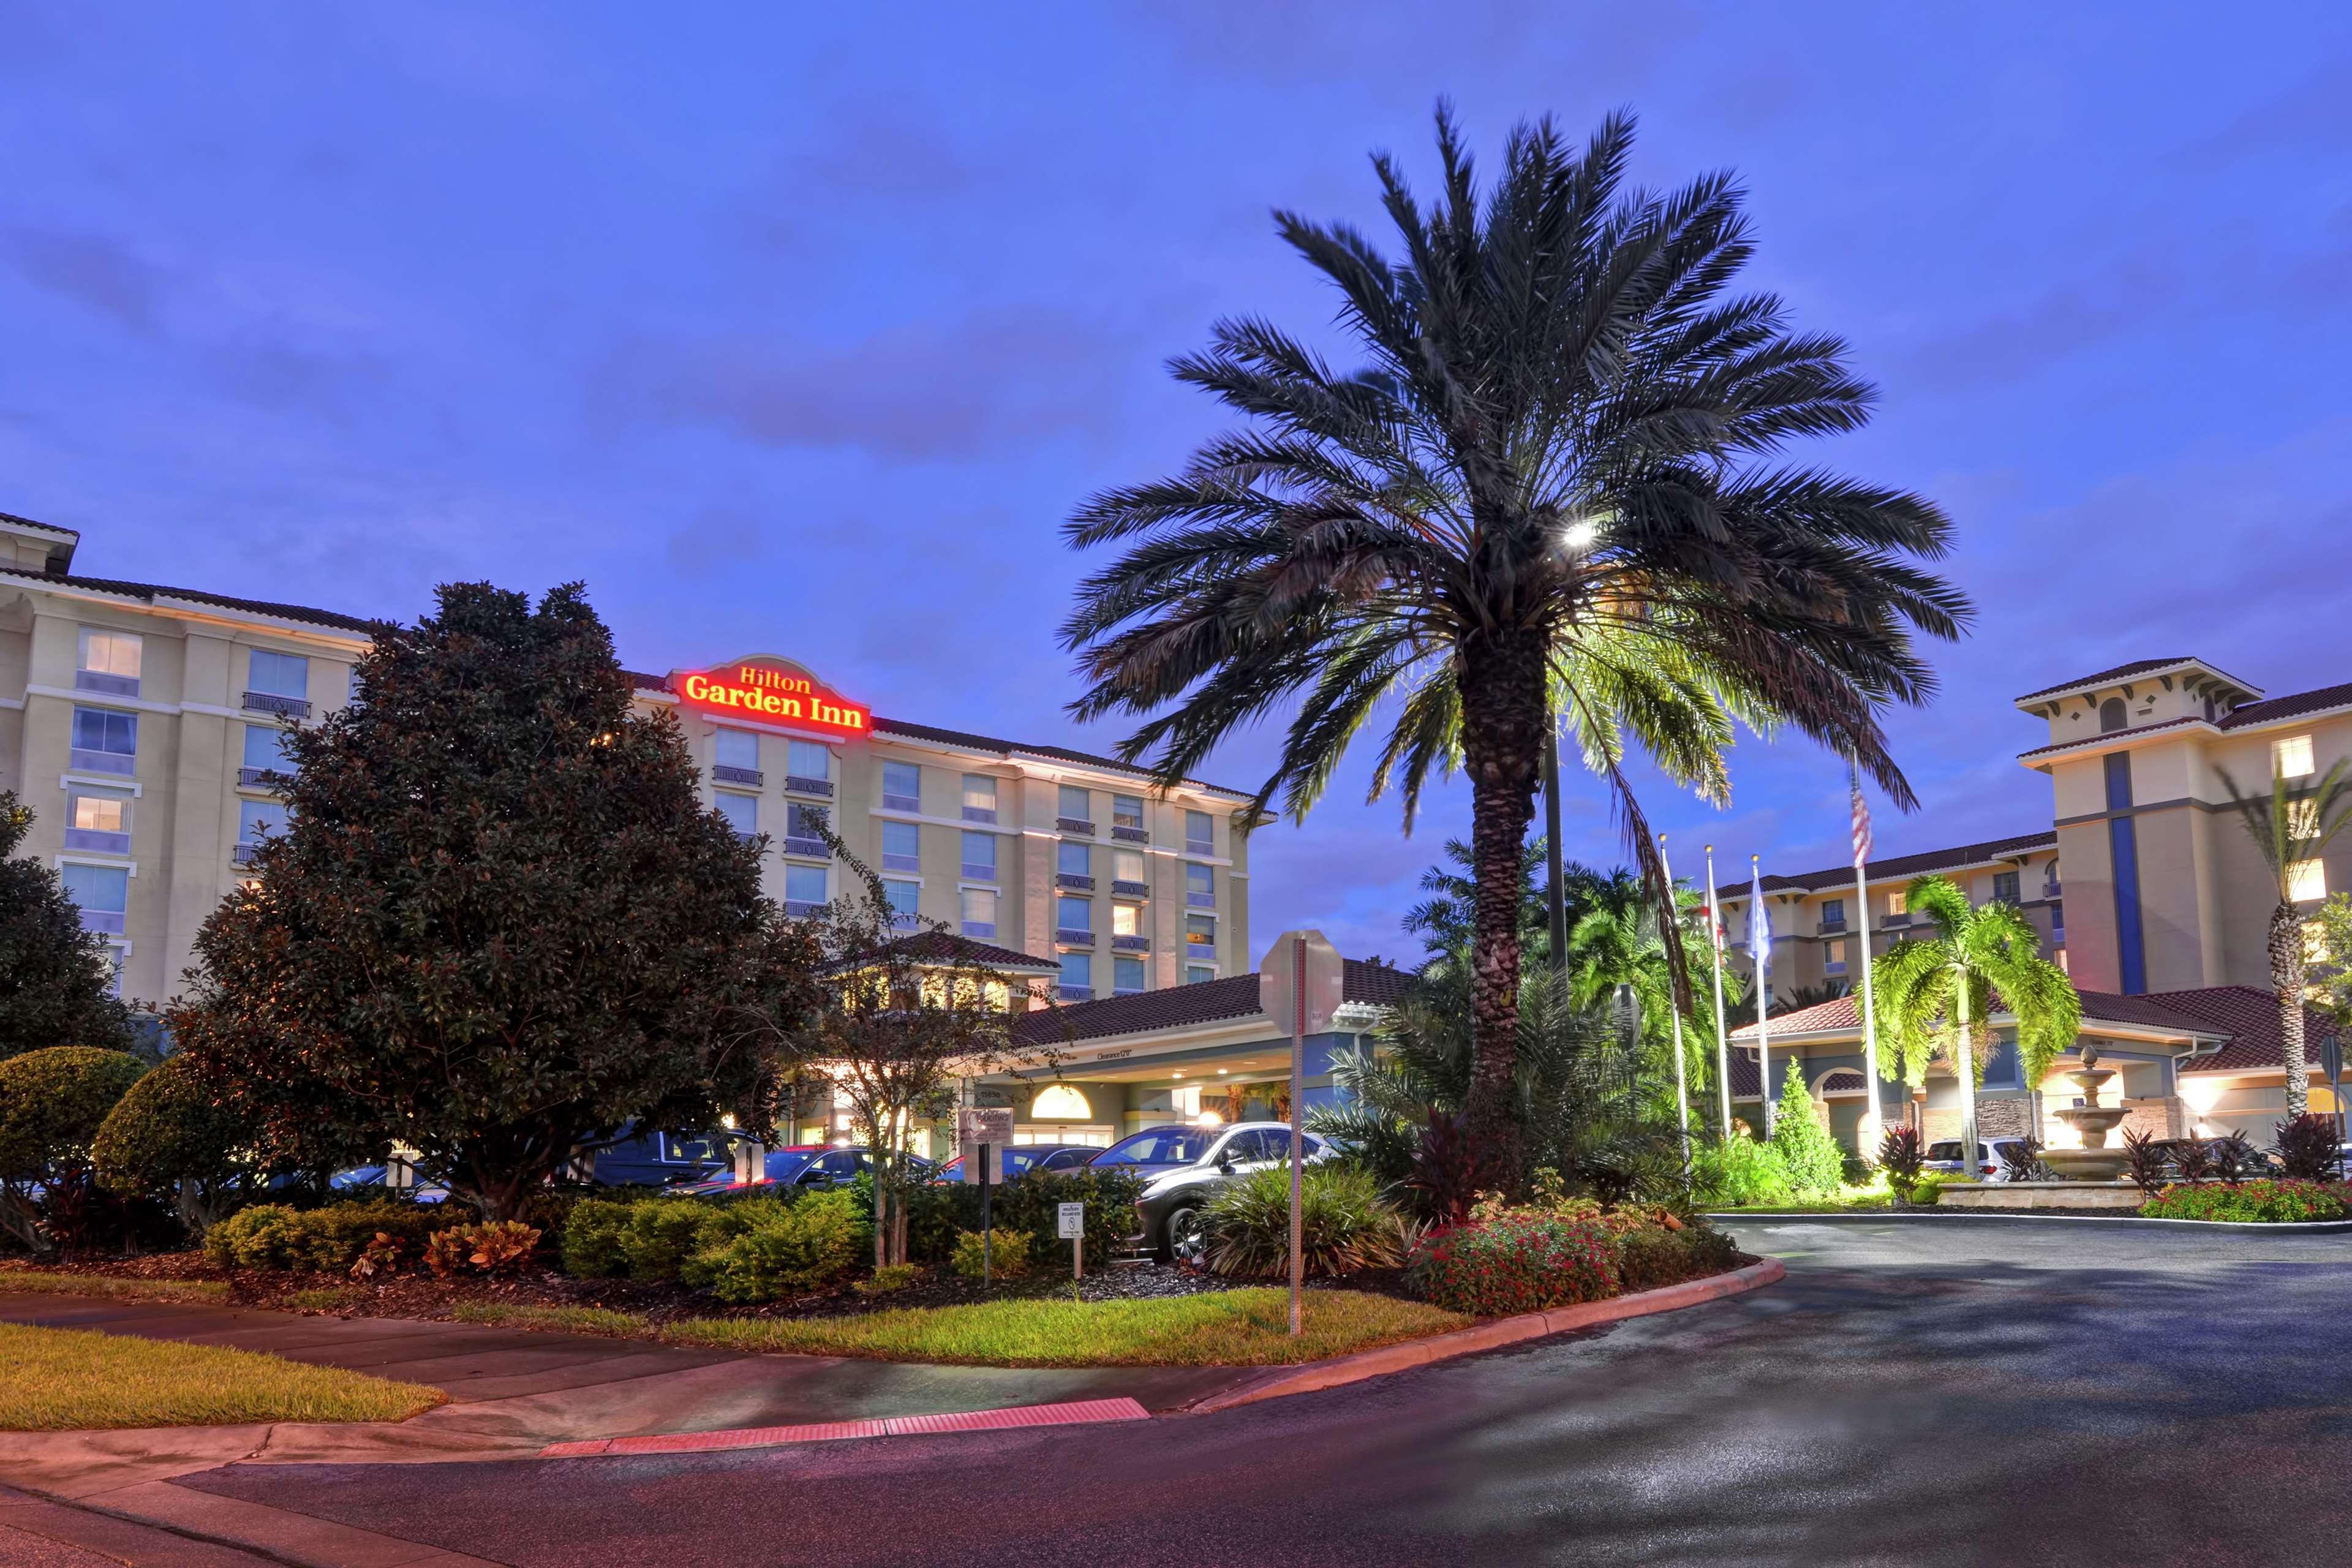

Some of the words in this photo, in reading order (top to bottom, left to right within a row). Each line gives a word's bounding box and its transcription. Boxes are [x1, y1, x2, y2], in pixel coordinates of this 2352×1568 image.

[741, 666, 812, 695] Hilton
[686, 676, 802, 718] Garden
[810, 697, 863, 728] Inn
